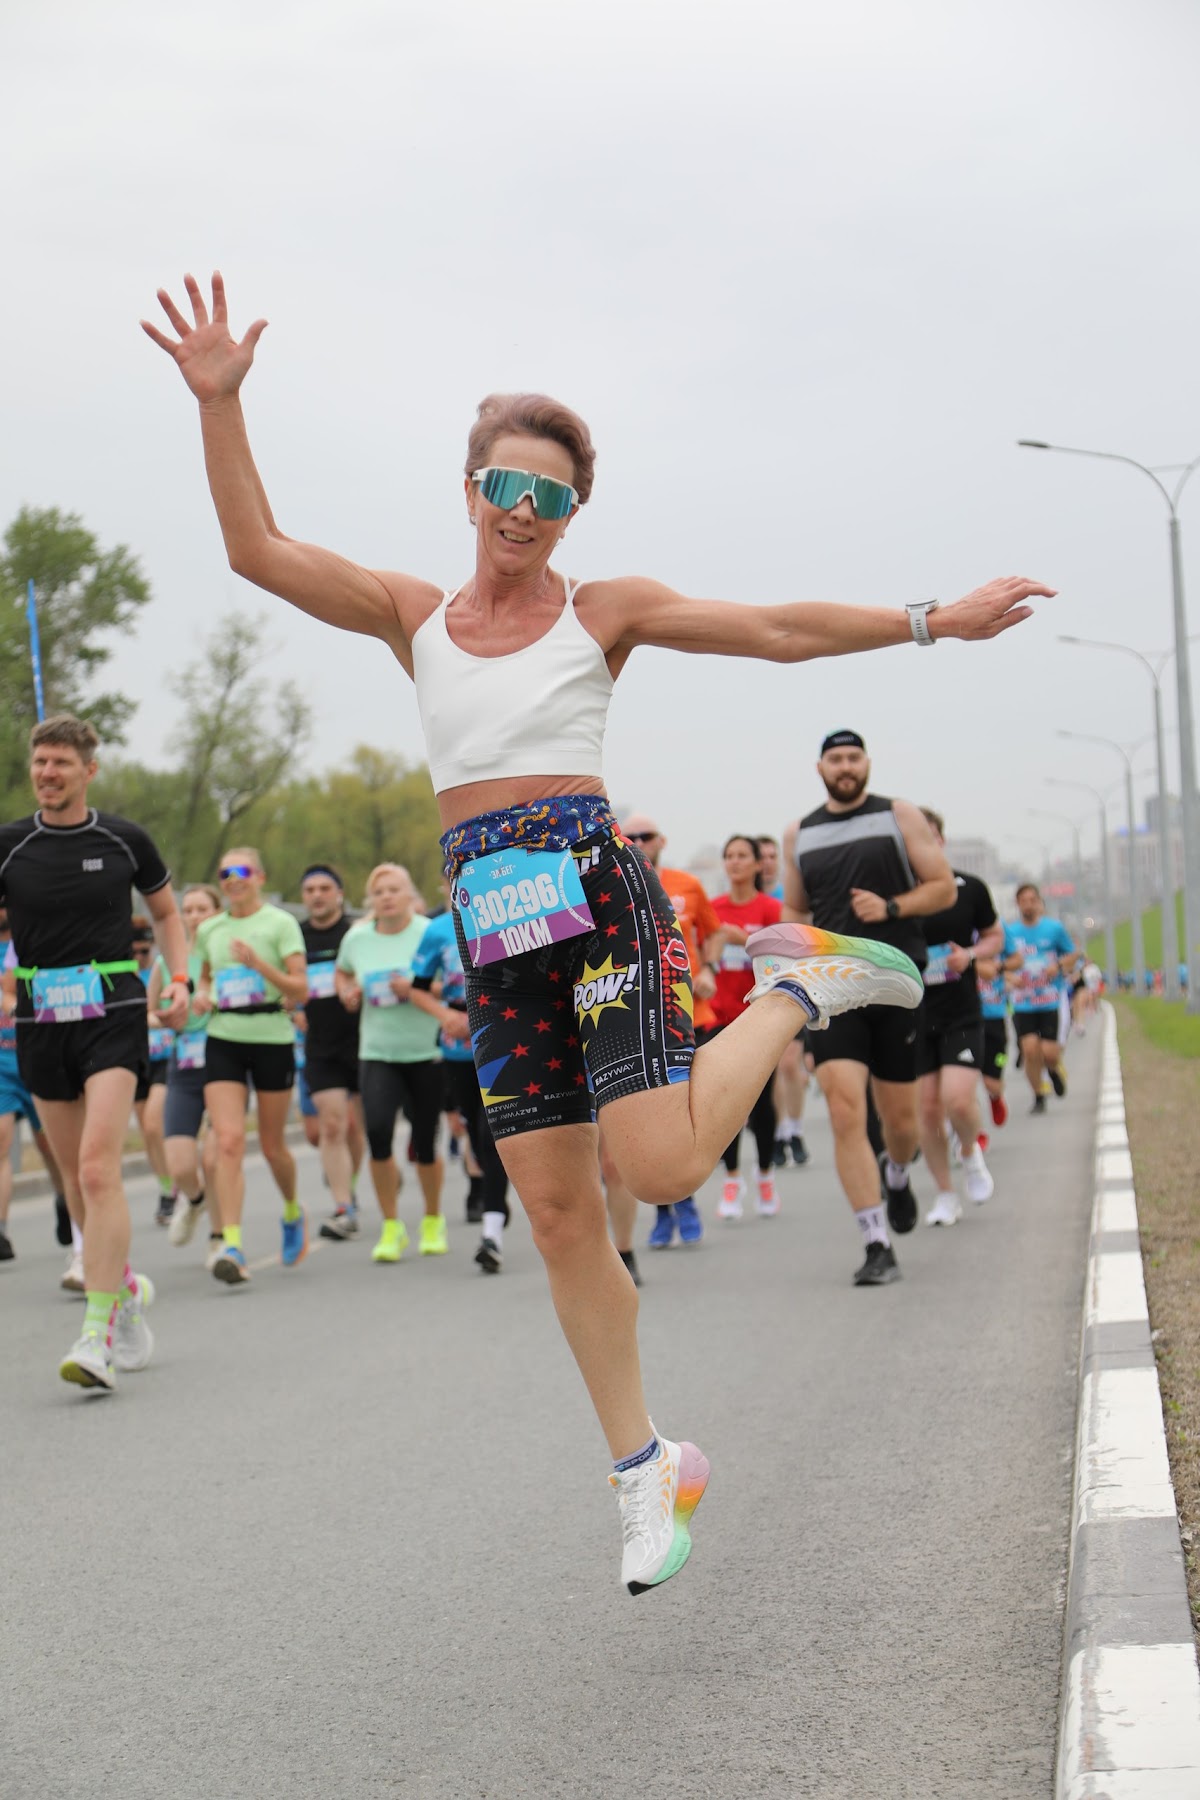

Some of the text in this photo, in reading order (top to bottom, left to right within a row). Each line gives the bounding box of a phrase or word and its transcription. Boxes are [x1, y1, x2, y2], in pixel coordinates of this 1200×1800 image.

[473, 873, 560, 930] 30296
[498, 916, 554, 957] 10KM
[574, 963, 639, 1014] POW!
[594, 1062, 635, 1086] EAZYWAY
